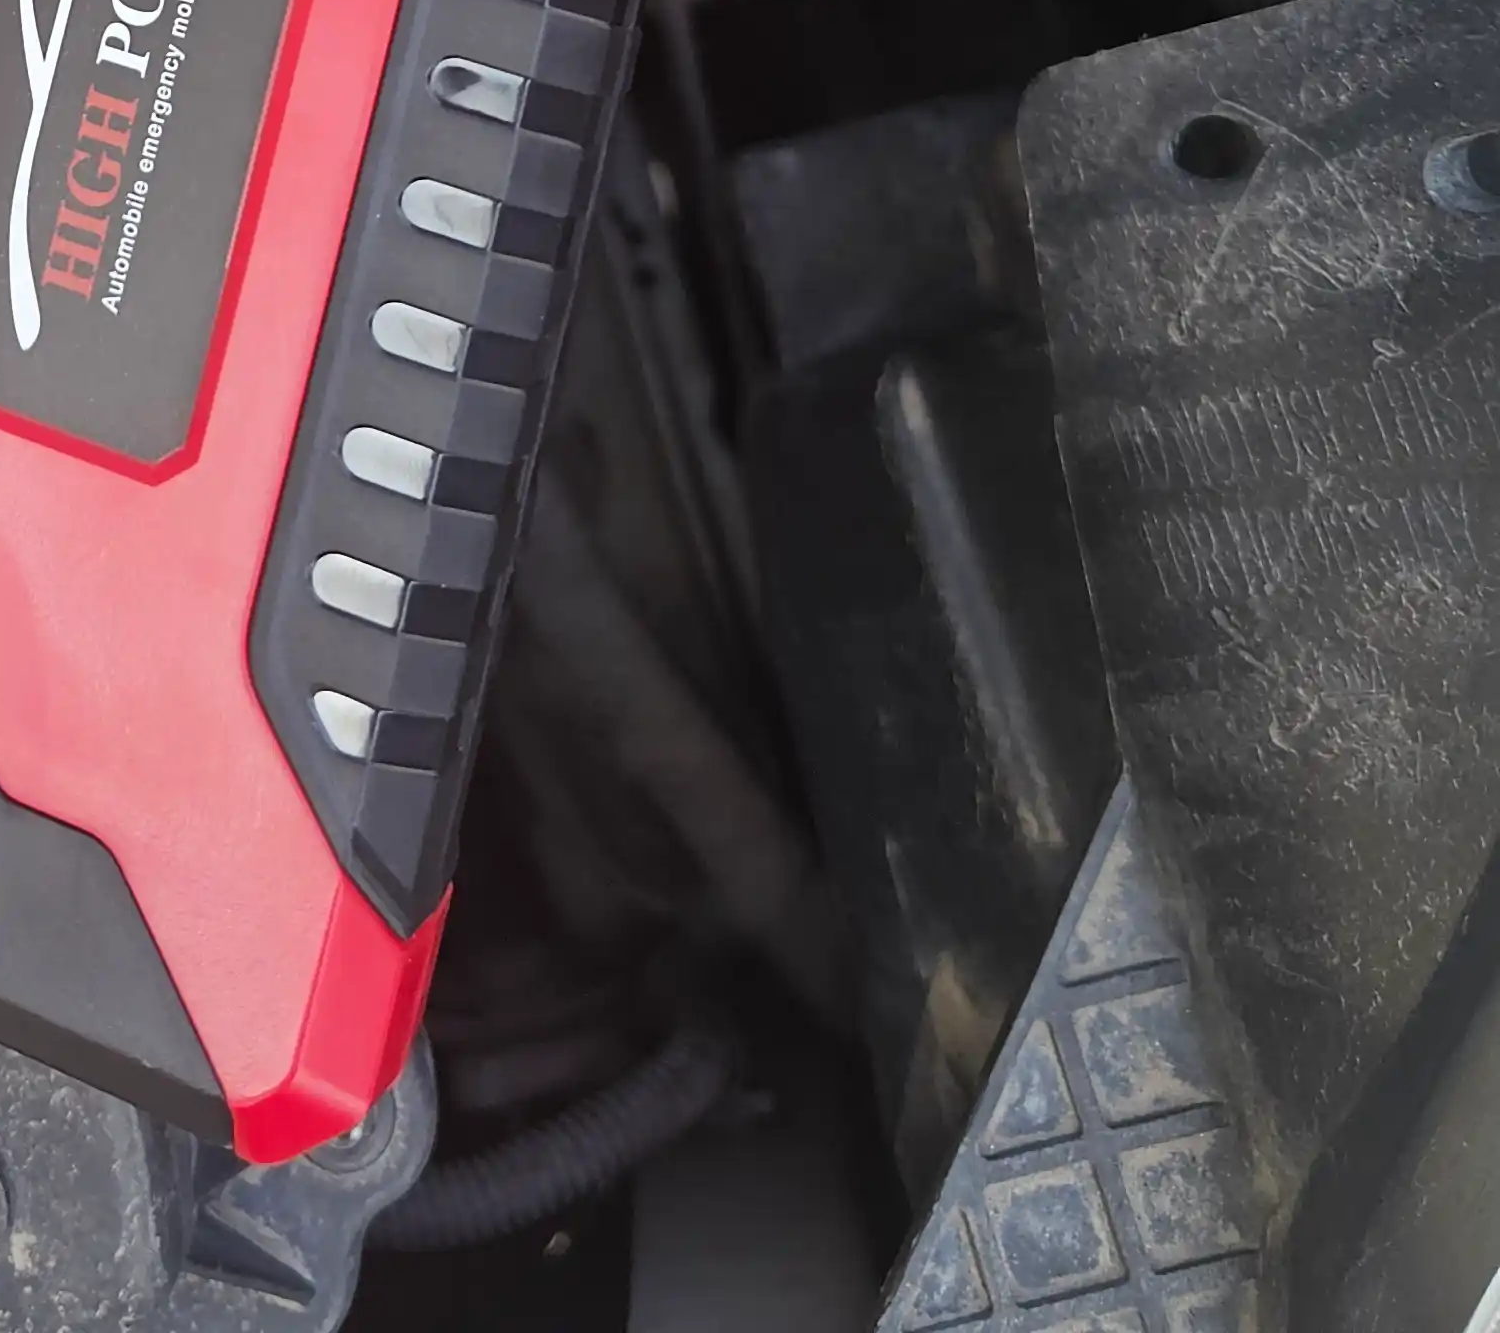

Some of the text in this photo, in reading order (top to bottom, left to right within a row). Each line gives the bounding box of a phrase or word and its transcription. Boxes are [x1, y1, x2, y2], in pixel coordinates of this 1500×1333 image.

[40, 83, 140, 302] HIGH
[100, 180, 149, 317] Automobile
[138, 43, 186, 174] emergency
